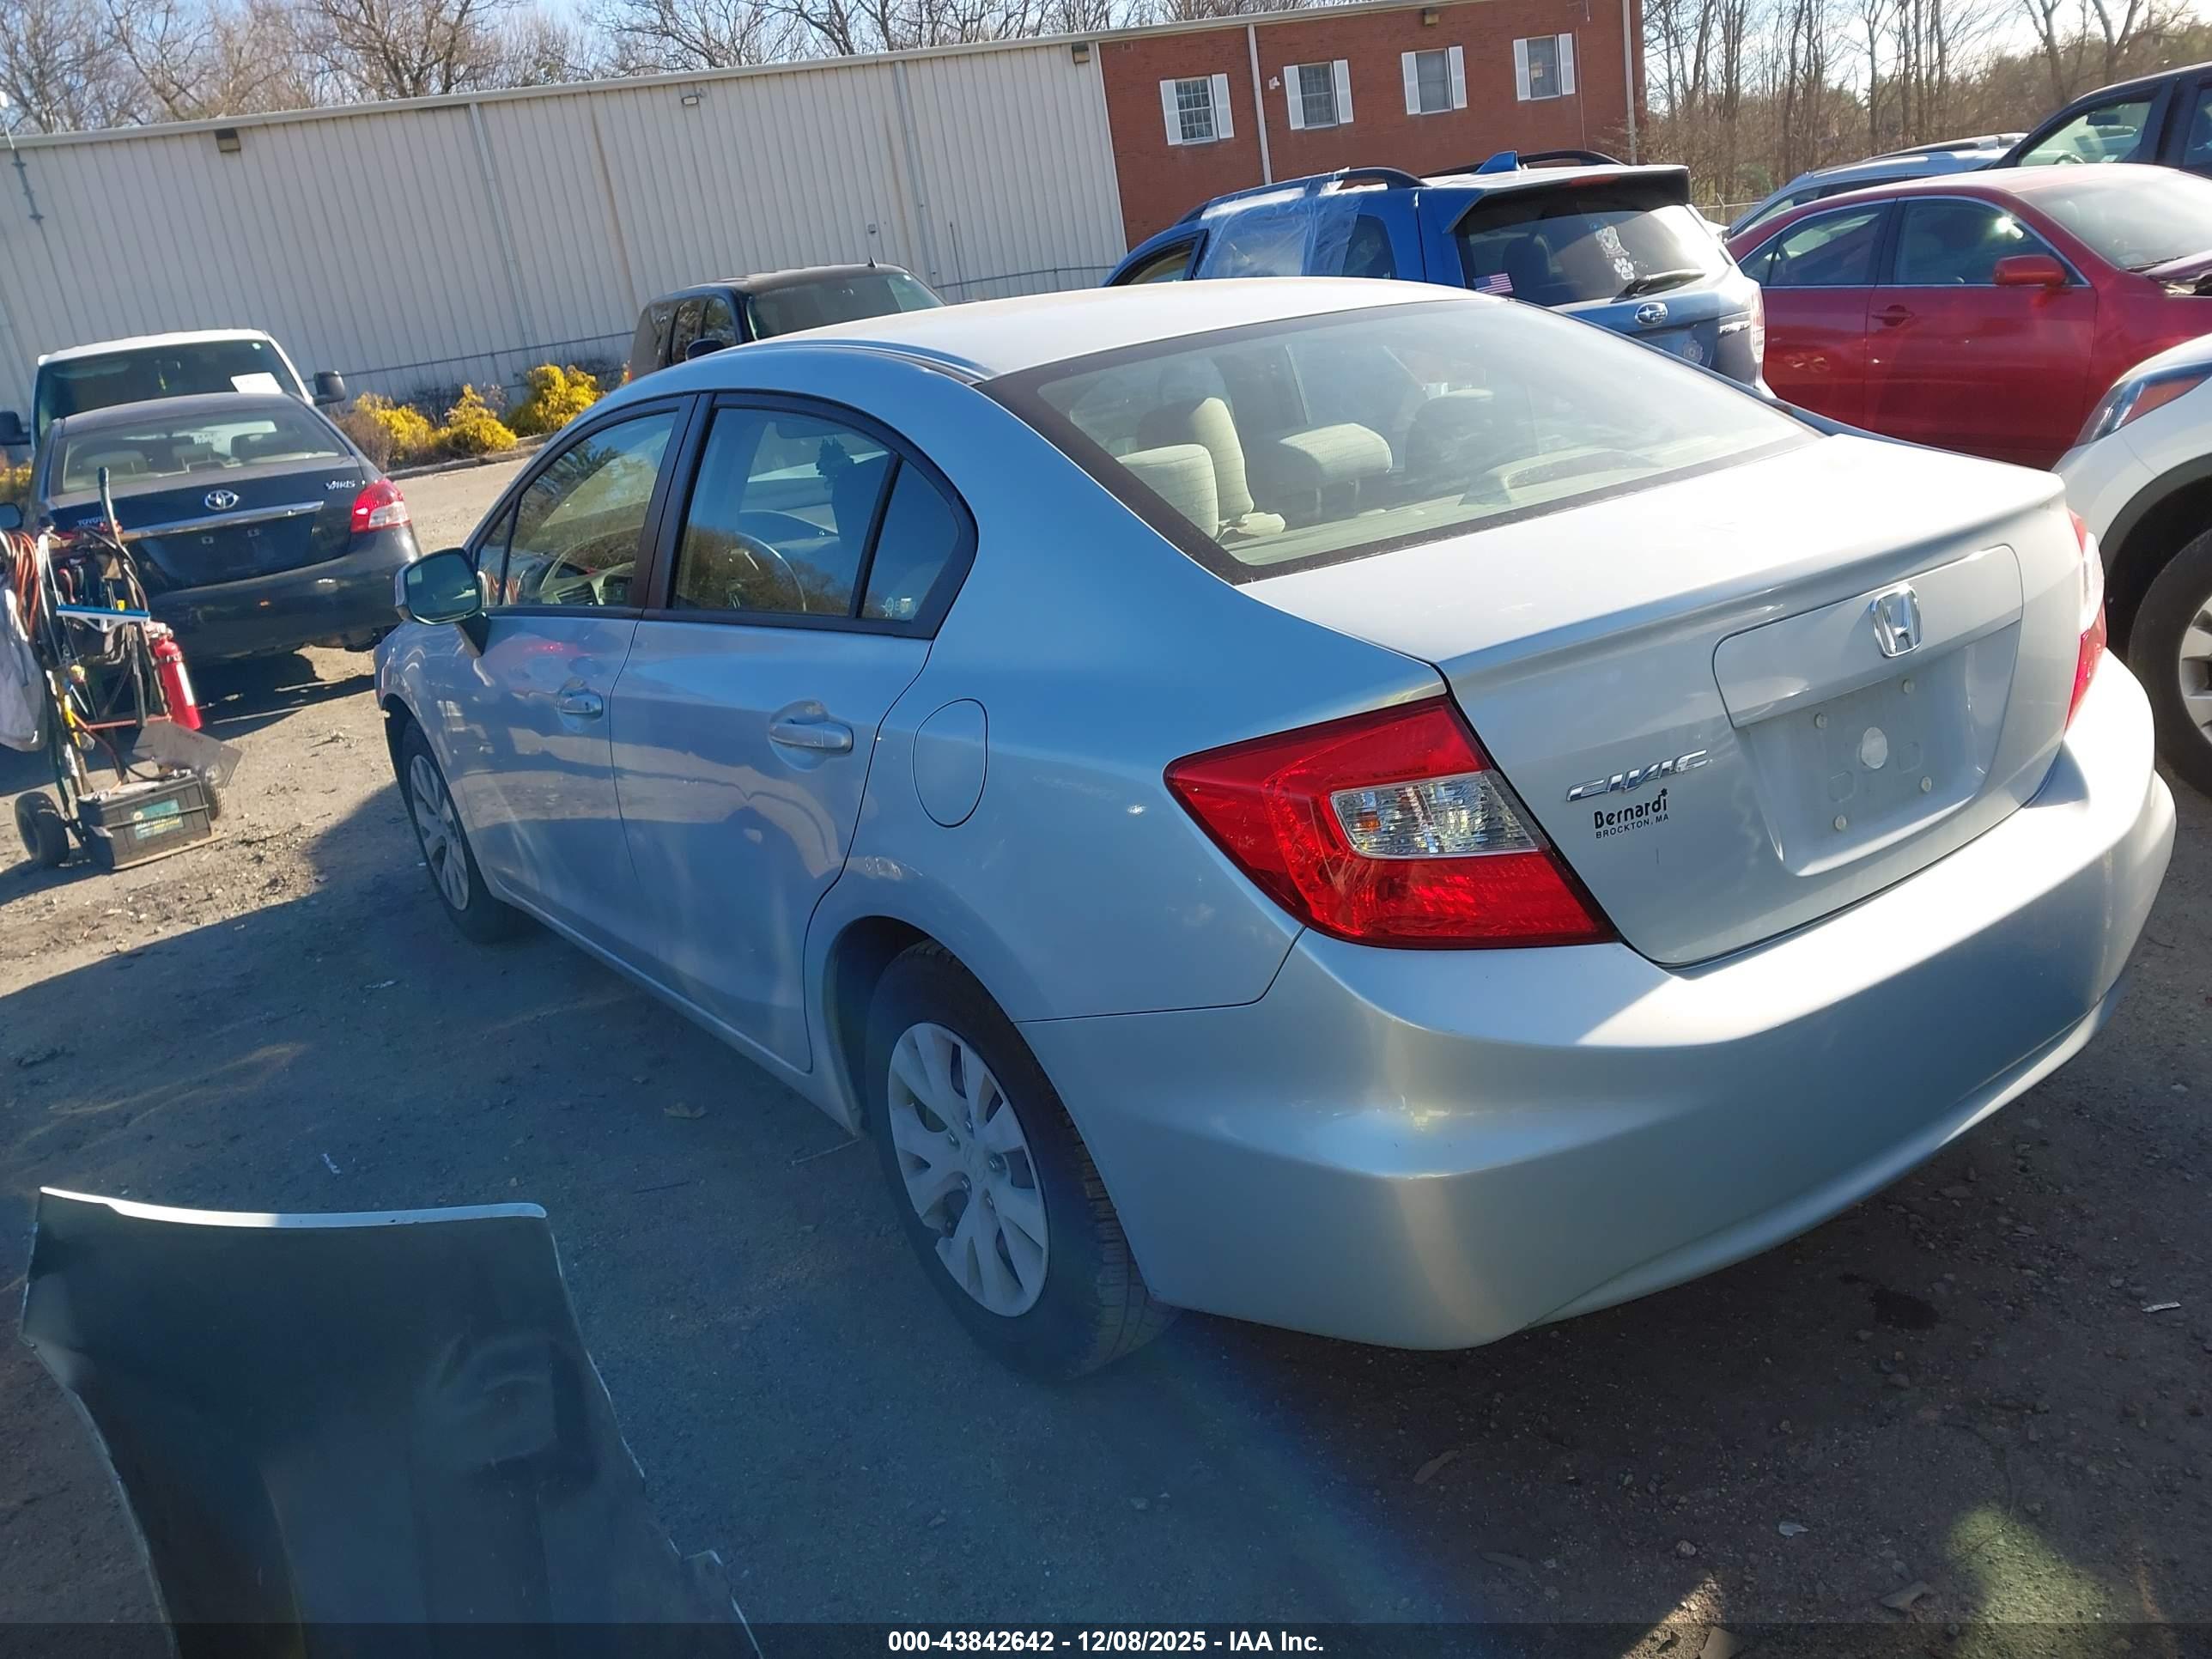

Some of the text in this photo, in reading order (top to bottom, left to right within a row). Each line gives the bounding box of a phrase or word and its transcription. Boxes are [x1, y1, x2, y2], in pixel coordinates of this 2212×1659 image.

[77, 516, 105, 526] TOYOT
[1566, 749, 1709, 802] CIVIC
[1594, 788, 1668, 829] Bernardi
[1656, 813, 1669, 824] MA
